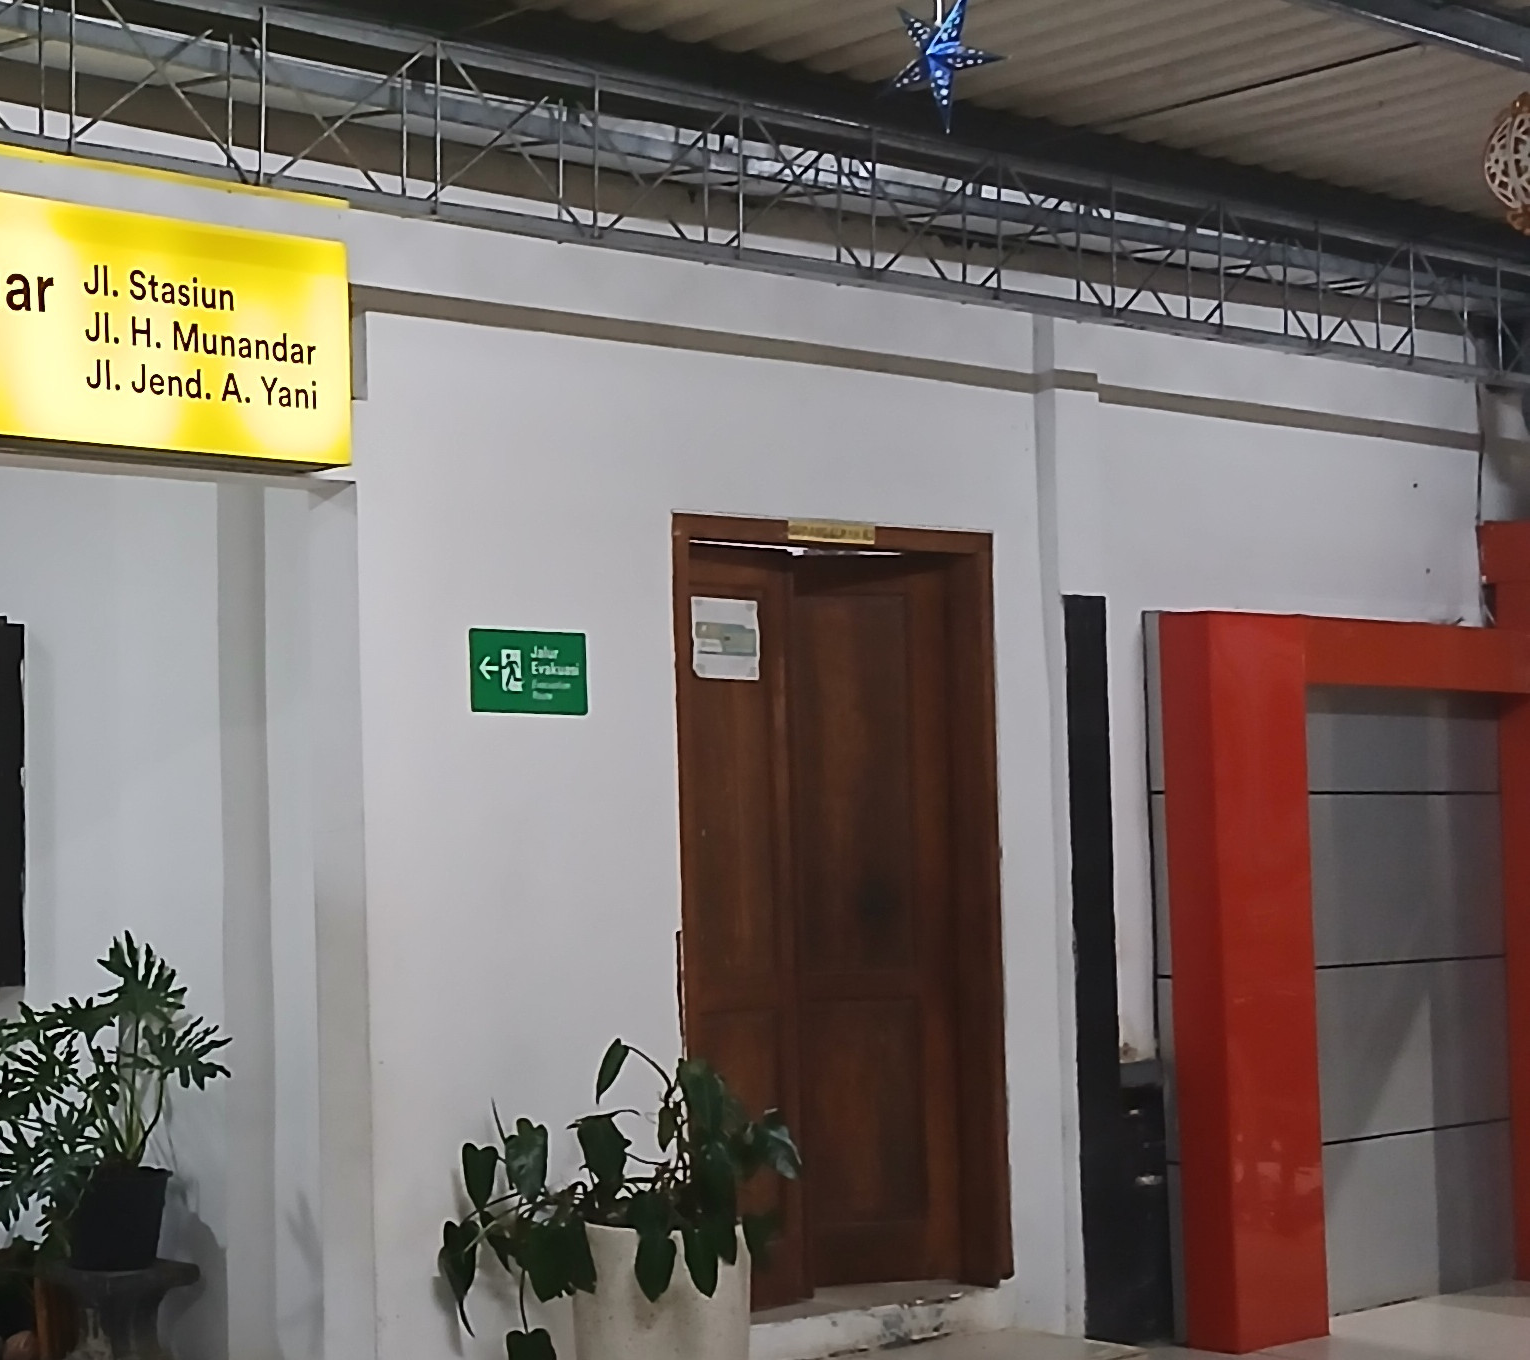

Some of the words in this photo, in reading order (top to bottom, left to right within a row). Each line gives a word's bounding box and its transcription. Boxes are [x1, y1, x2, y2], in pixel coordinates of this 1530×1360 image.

[83, 264, 119, 298] Jl.
[129, 269, 235, 312] Stasiun
[84, 311, 120, 345] Jl.
[131, 315, 162, 349] H.
[172, 320, 317, 366] Munandar
[86, 358, 121, 391] Jl.
[131, 363, 212, 400] Jend.
[221, 372, 251, 404] A.
[260, 375, 318, 410] Yani
